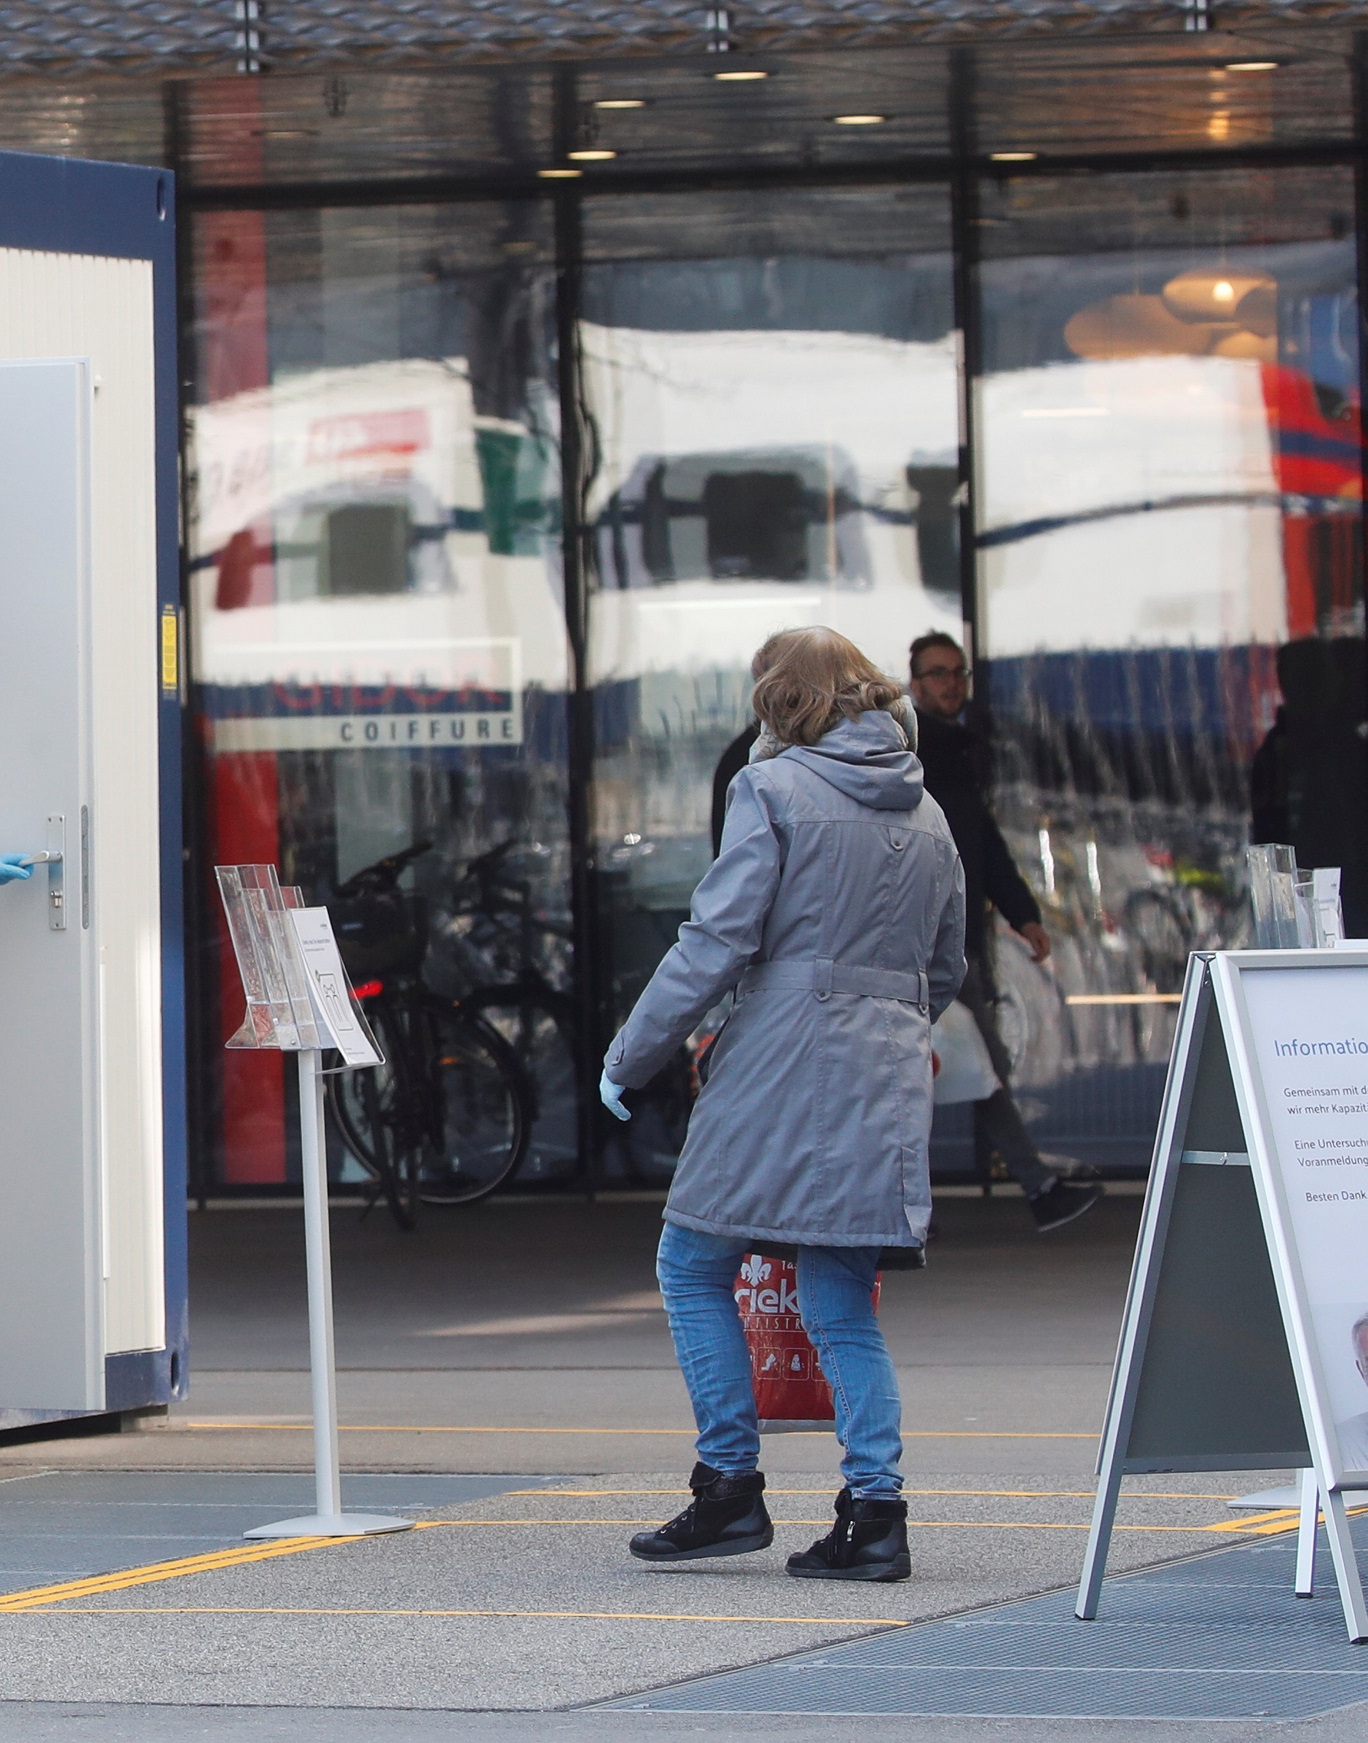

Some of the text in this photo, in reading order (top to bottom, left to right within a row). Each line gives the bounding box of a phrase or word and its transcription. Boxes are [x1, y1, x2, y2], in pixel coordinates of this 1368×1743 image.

[339, 718, 513, 743] COIFFURE
[1274, 1037, 1368, 1056] Informatio
[1283, 1086, 1340, 1098] Gemeinsam
[1342, 1085, 1359, 1096] mit
[1287, 1104, 1302, 1115] wir
[1304, 1104, 1329, 1114] mehr
[1294, 1139, 1316, 1150] Eine
[1297, 1156, 1368, 1167] Voranmeldung
[1306, 1190, 1367, 1202] Besten Dank
[734, 1278, 801, 1313] riek
